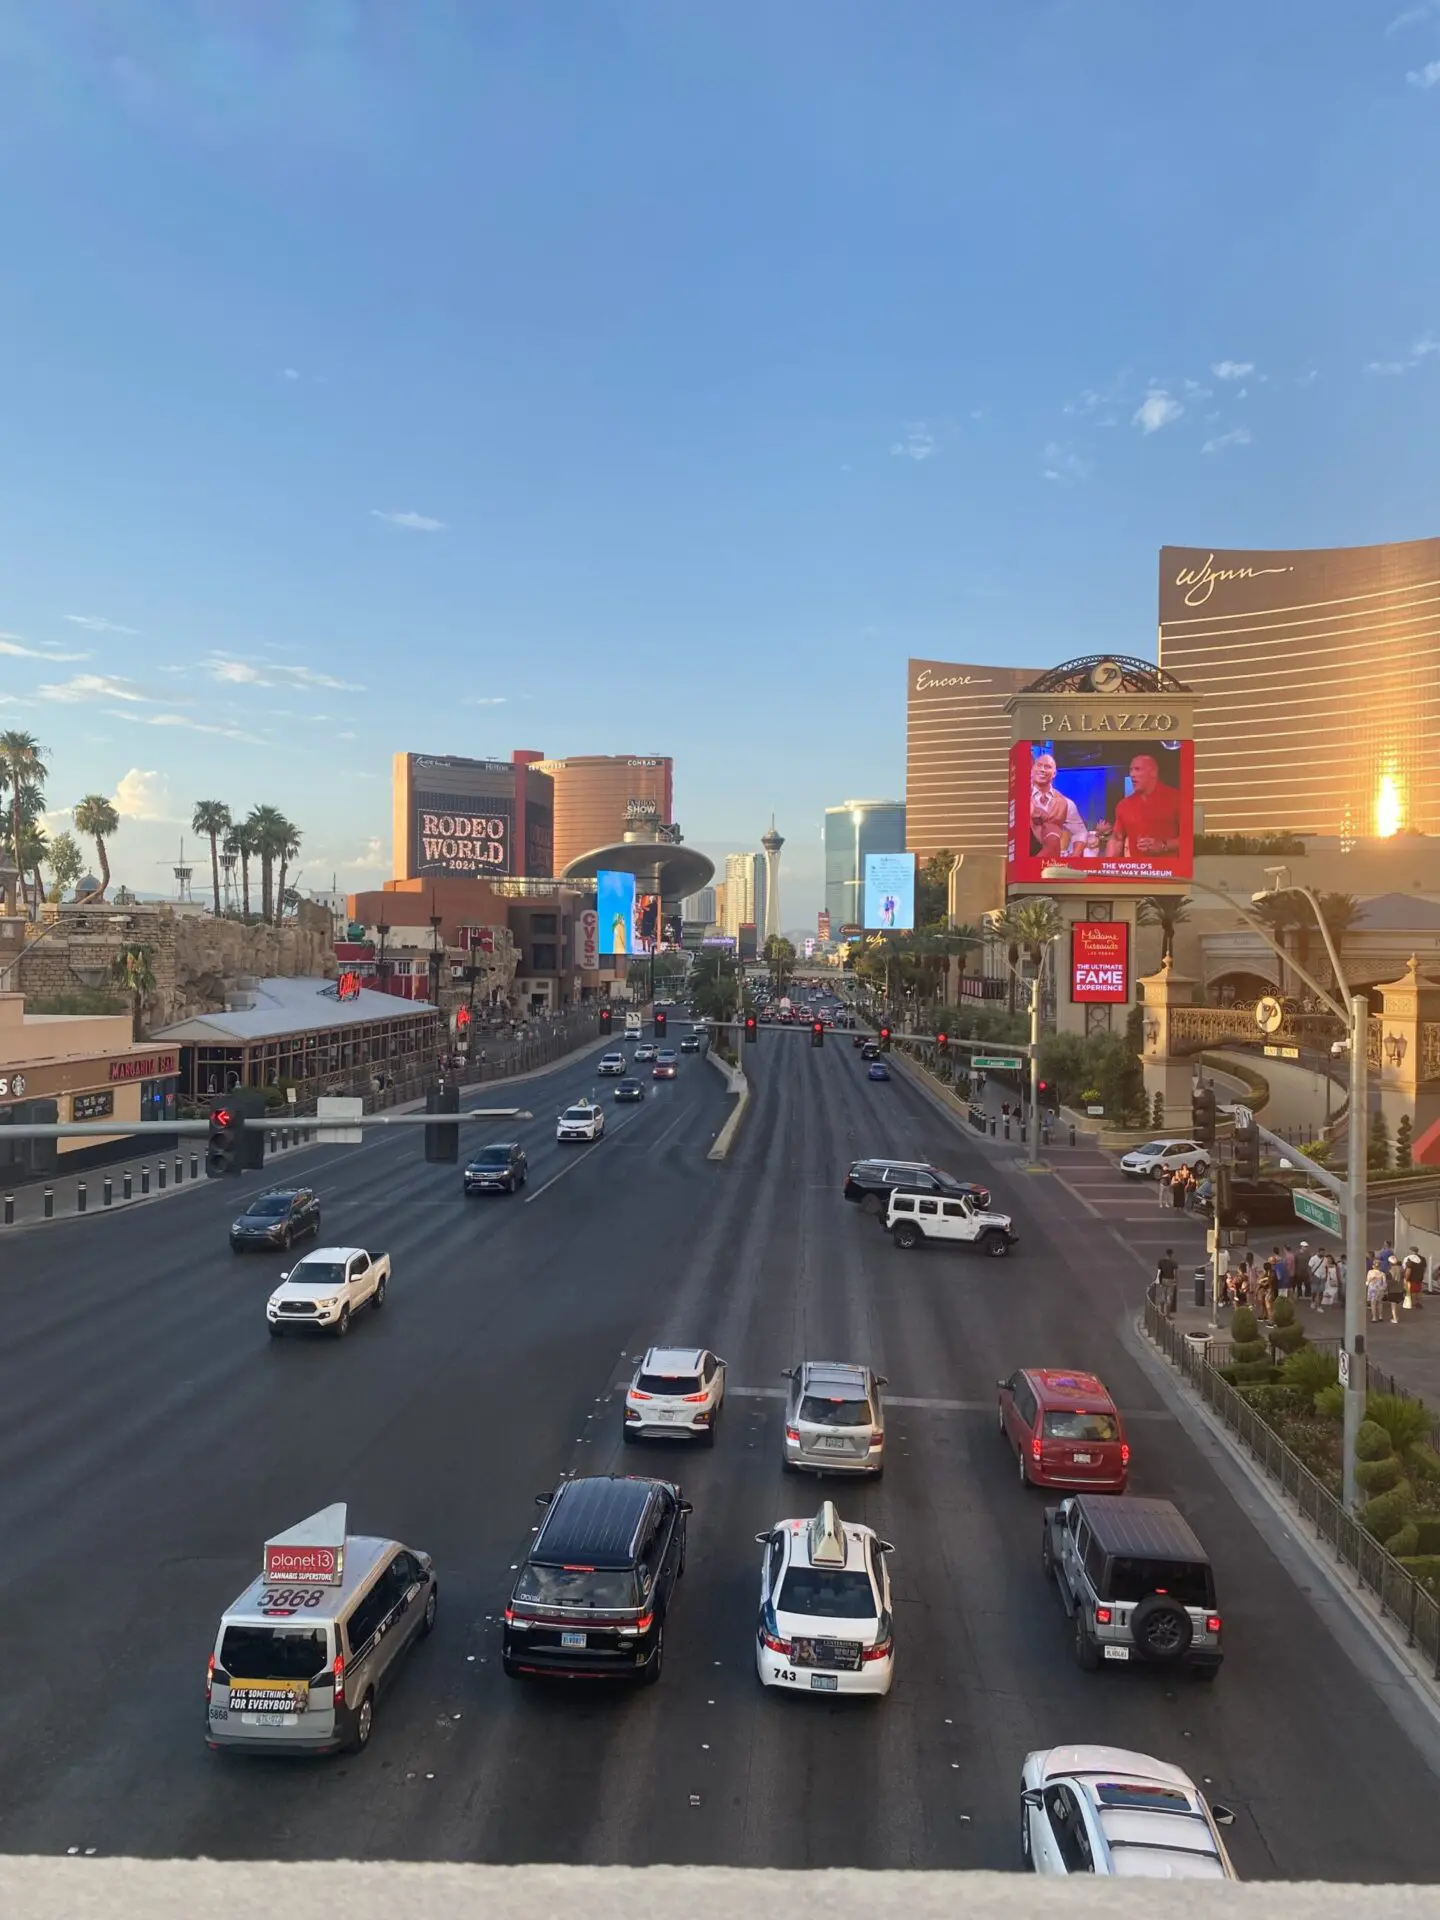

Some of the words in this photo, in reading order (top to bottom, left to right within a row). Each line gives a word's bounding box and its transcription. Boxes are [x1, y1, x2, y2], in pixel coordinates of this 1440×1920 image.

[1176, 553, 1293, 606] Wynn
[916, 669, 993, 691] Encore
[1042, 714, 1172, 732] PALAZZO
[627, 759, 657, 767] CONRAD
[626, 805, 656, 814] SHOW
[423, 815, 504, 839] RODEO
[423, 837, 504, 864] WORLD
[449, 860, 476, 870] 2024
[1102, 862, 1117, 870] THE
[1118, 862, 1153, 870] WORLD'S
[583, 913, 596, 953] CVS
[1081, 928, 1120, 941] Madame
[1081, 940, 1119, 950] Tussauds
[1090, 963, 1123, 971] ULTIMATE
[1076, 971, 1123, 984] FAME
[1076, 984, 1124, 992] EXPERIENCE
[109, 1059, 156, 1080] MARGARITA
[270, 1572, 298, 1580] CANNABIS
[299, 1573, 332, 1581] SUPERSTORE
[257, 1589, 325, 1608] 5868
[774, 1668, 797, 1681] 743
[230, 1689, 236, 1697] A
[237, 1689, 248, 1698] LIL'
[248, 1690, 286, 1698] SOMETHING
[230, 1699, 246, 1709] FOR
[248, 1699, 297, 1711] EVERYBODY
[209, 1708, 229, 1721] 5868
